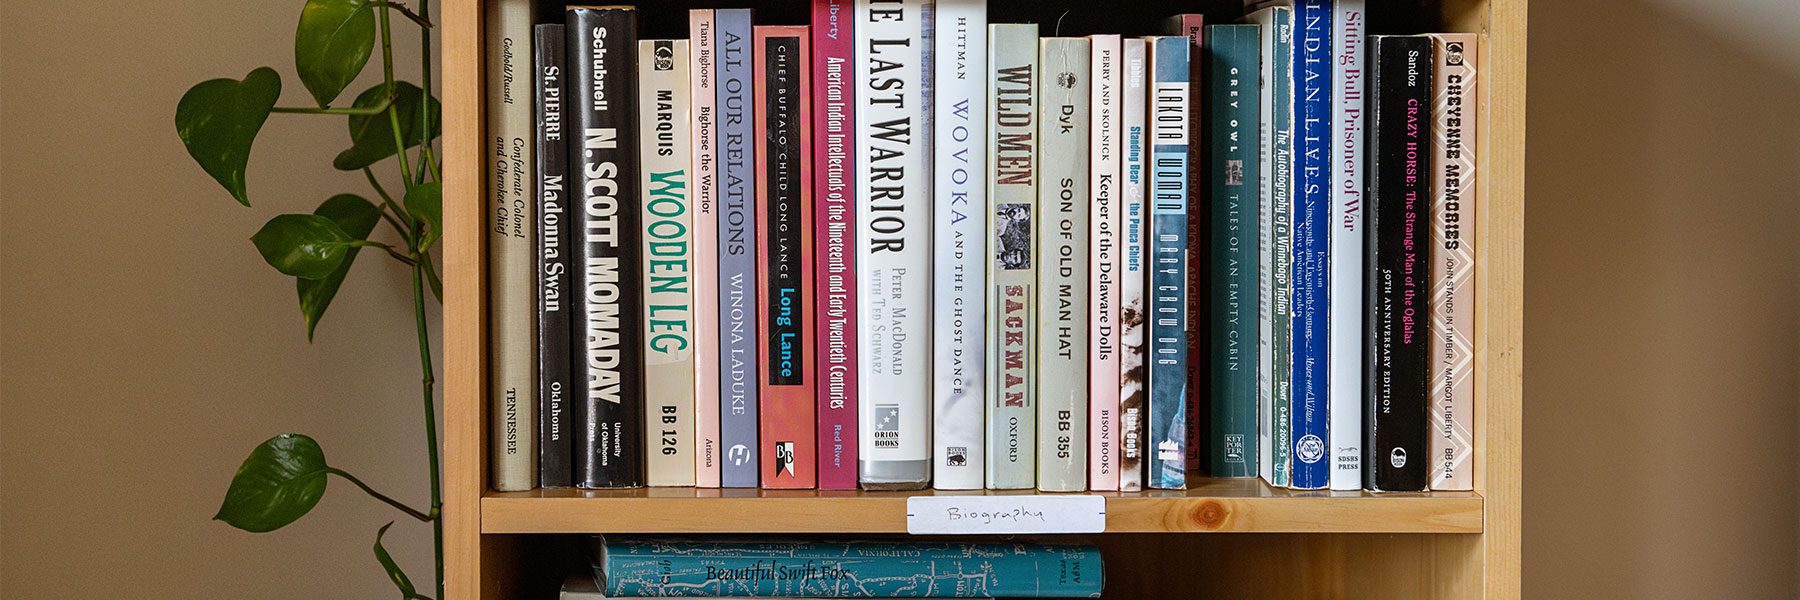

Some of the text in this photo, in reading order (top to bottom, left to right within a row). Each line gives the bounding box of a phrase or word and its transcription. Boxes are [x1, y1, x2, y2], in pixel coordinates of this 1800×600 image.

[503, 38, 513, 104] Godbold/Russell
[593, 26, 608, 110] Schubnell
[698, 22, 710, 88] Tiana Bighorse
[958, 17, 966, 80] HITTMAN
[1280, 24, 1288, 44] Radin
[1408, 50, 1418, 87] Sandoz
[544, 66, 560, 142] St. PIERRE
[657, 90, 673, 156] MARQUIS
[997, 64, 1032, 186] WILD MEN
[1060, 104, 1074, 135] Dyk
[1102, 50, 1110, 160] PERRY AND SKOLNICK
[1158, 88, 1183, 139] LAKOTA
[1230, 67, 1238, 152] GREY OWL
[1277, 130, 1288, 144] The
[1304, 4, 1320, 196] INDIAN LIVES
[1340, 11, 1360, 232] Sitting Bull, Prisoner of War
[1446, 74, 1462, 160] CHEYENNE
[698, 106, 711, 214] Bighorse the Warrior
[726, 31, 744, 256] ALL OUR RELATIONS
[778, 45, 788, 279] CHIEF BUFFALO CHILD LONG LANCE
[870, 38, 910, 254] LAST WARRIOR
[1157, 158, 1182, 210] WOMAN
[1276, 149, 1288, 214] Autobiography
[495, 136, 508, 236] and Cherokee Chief
[513, 137, 525, 238] Confederate Colonel
[1128, 126, 1140, 272] Standing Bear the Ponca Chiefs
[1276, 216, 1288, 226] of
[1403, 98, 1417, 344] CRAZY HORSE: The Strange Man of the Oglalas
[1445, 164, 1460, 250] MEMORIES
[544, 174, 564, 312] Madonna Swan
[585, 127, 620, 404] N. SCOTT MOMADAY
[646, 170, 688, 354] WOODEN LEG
[826, 57, 847, 410] American Indian Intellectuals of the Nineteenth and Early Twentieth Centuries
[951, 98, 968, 394] WOVOKA AND THE GHOST DANCE
[1060, 178, 1073, 360] SON OF OLD MAN HAT
[1097, 174, 1112, 360] Keeper of the Delaware Dolls
[1276, 236, 1288, 284] Winnebago
[1159, 234, 1178, 364] MARY CROW DOG
[1230, 194, 1238, 372] TALES OF AN EMPTY CABIN
[1277, 287, 1288, 315] Indian
[730, 272, 744, 416] WINONA LADUKE
[777, 288, 796, 377] Long Lance
[1005, 285, 1024, 408] SACKMAN
[1382, 269, 1392, 414] 50TH ANNIVERSARY EDITION
[1445, 256, 1454, 440] JOHN STANDS IN TIMBER MARGOT LIBERTY
[506, 388, 517, 454] TENNESSEE
[551, 382, 562, 440] Oklahoma
[602, 422, 608, 430] of
[662, 406, 676, 456] BB 126
[834, 424, 842, 468] Red River
[1008, 416, 1018, 462] OXFORD
[1058, 410, 1070, 459] BB 355
[1102, 410, 1110, 475] BISON BOOKS
[1124, 408, 1138, 458] Bison Books
[1280, 381, 1288, 457] Dover 0-486-20096-5
[1445, 448, 1453, 479] BB 544
[947, 507, 1046, 524] Biography
[706, 560, 849, 586] Beautiful Swift Fox
